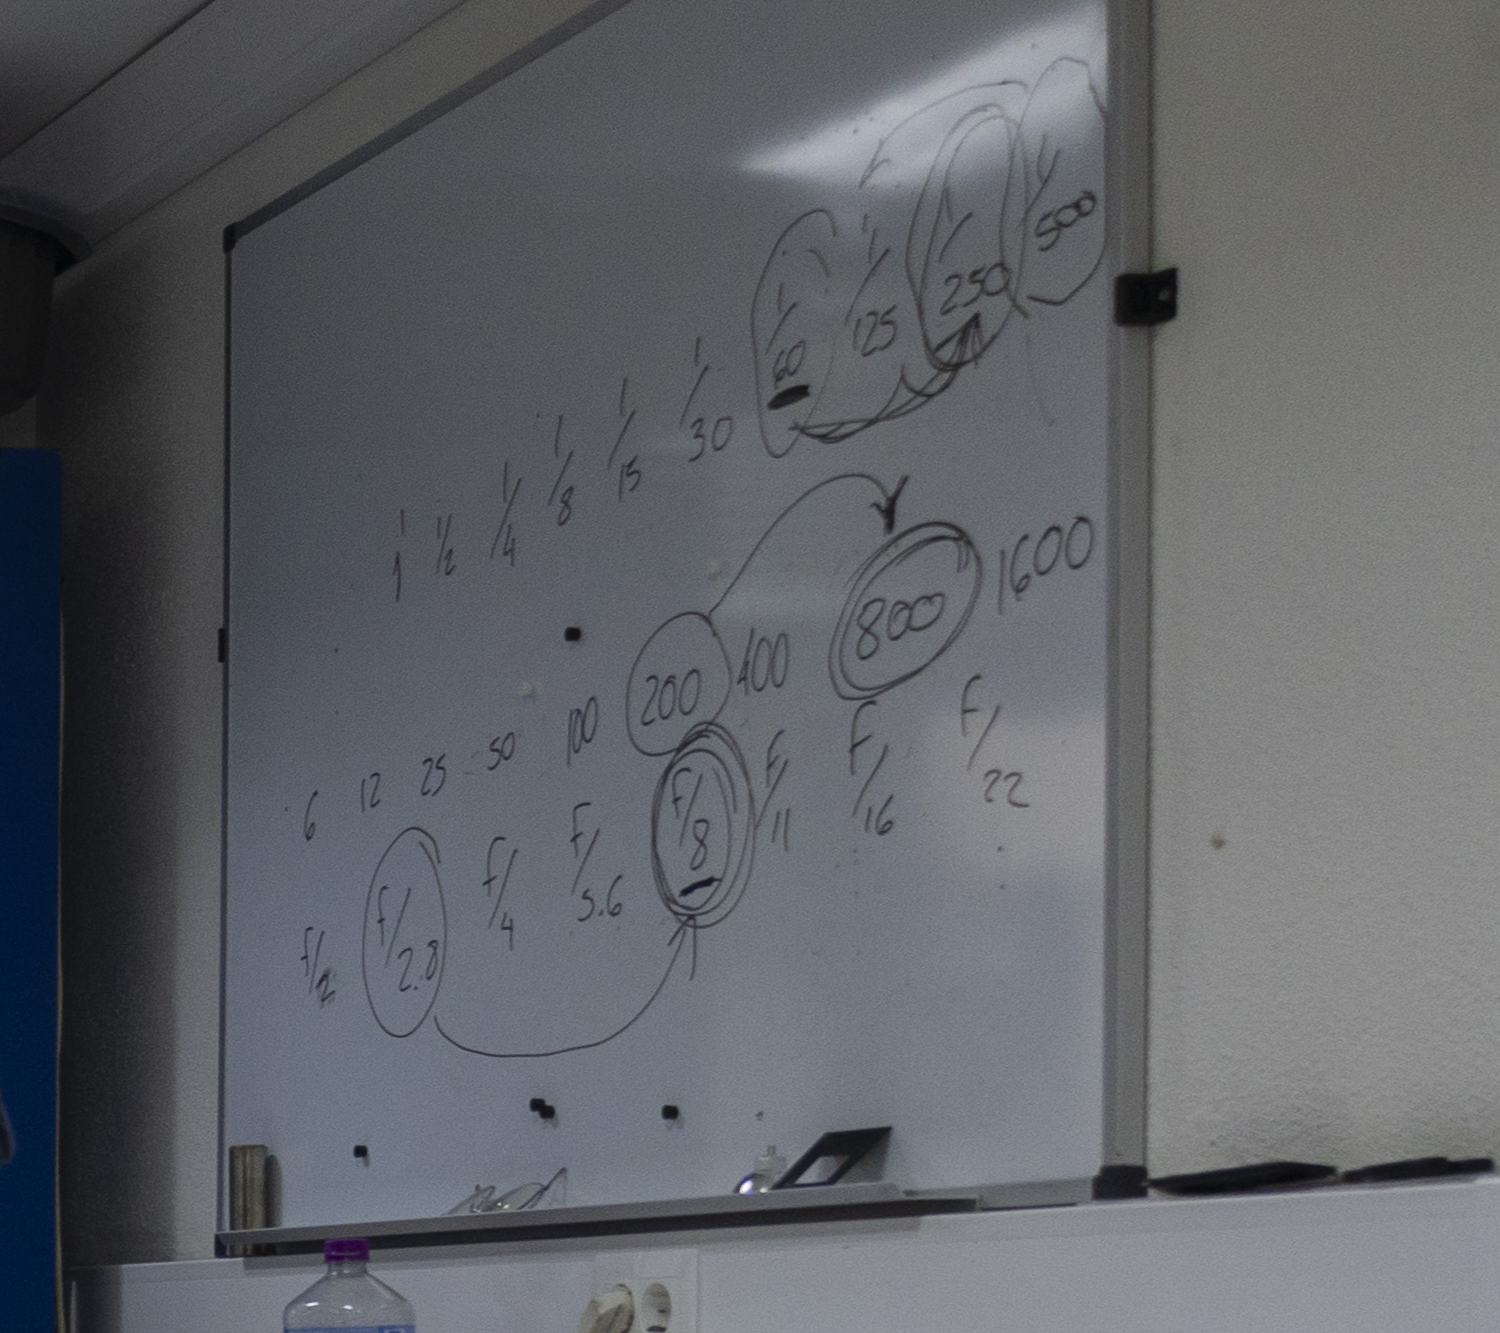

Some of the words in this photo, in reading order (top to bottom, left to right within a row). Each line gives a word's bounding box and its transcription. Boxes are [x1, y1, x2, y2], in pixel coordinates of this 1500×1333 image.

[303, 790, 319, 842] 6
[360, 771, 382, 813] 12
[420, 753, 448, 798] 25
[487, 731, 517, 772] 50
[567, 695, 600, 768] 100
[641, 667, 703, 727] 200
[736, 626, 791, 697] 400
[856, 591, 946, 661] 800
[997, 515, 1095, 616] 1600
